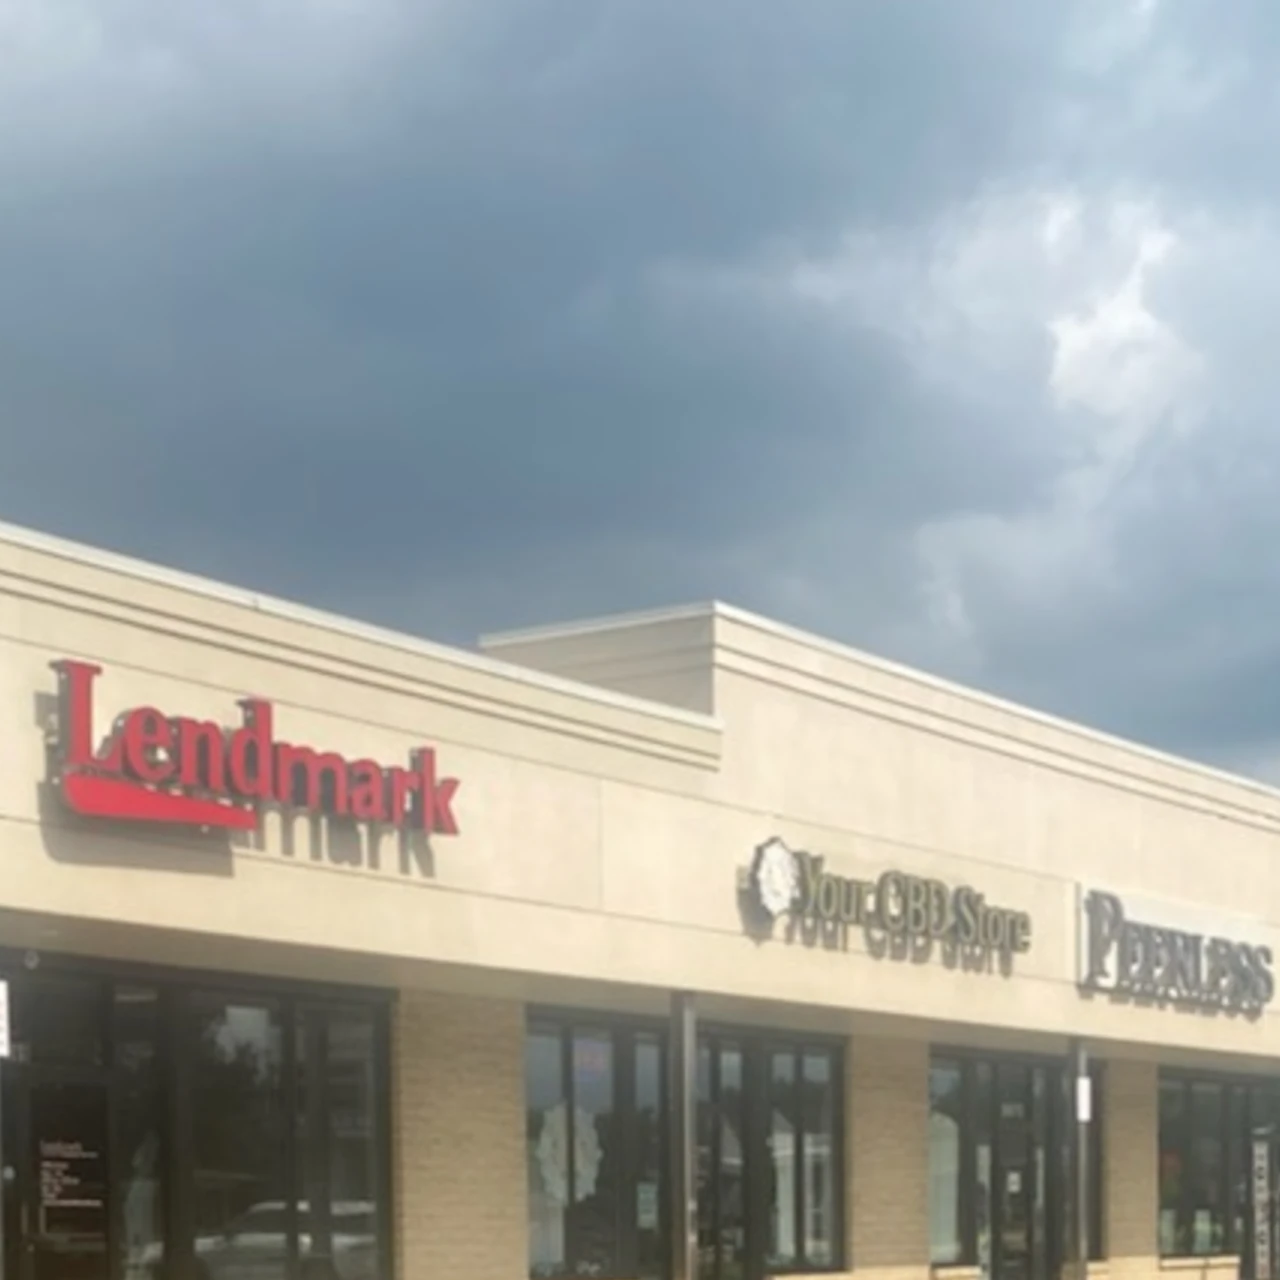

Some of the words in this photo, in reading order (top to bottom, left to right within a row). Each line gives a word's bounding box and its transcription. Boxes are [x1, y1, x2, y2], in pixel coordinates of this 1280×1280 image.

[51, 658, 460, 836] Lendmark
[799, 850, 876, 922] Your
[876, 869, 951, 938] CBD
[952, 885, 1031, 954] Store
[1084, 888, 1274, 1006] PEERLESS
